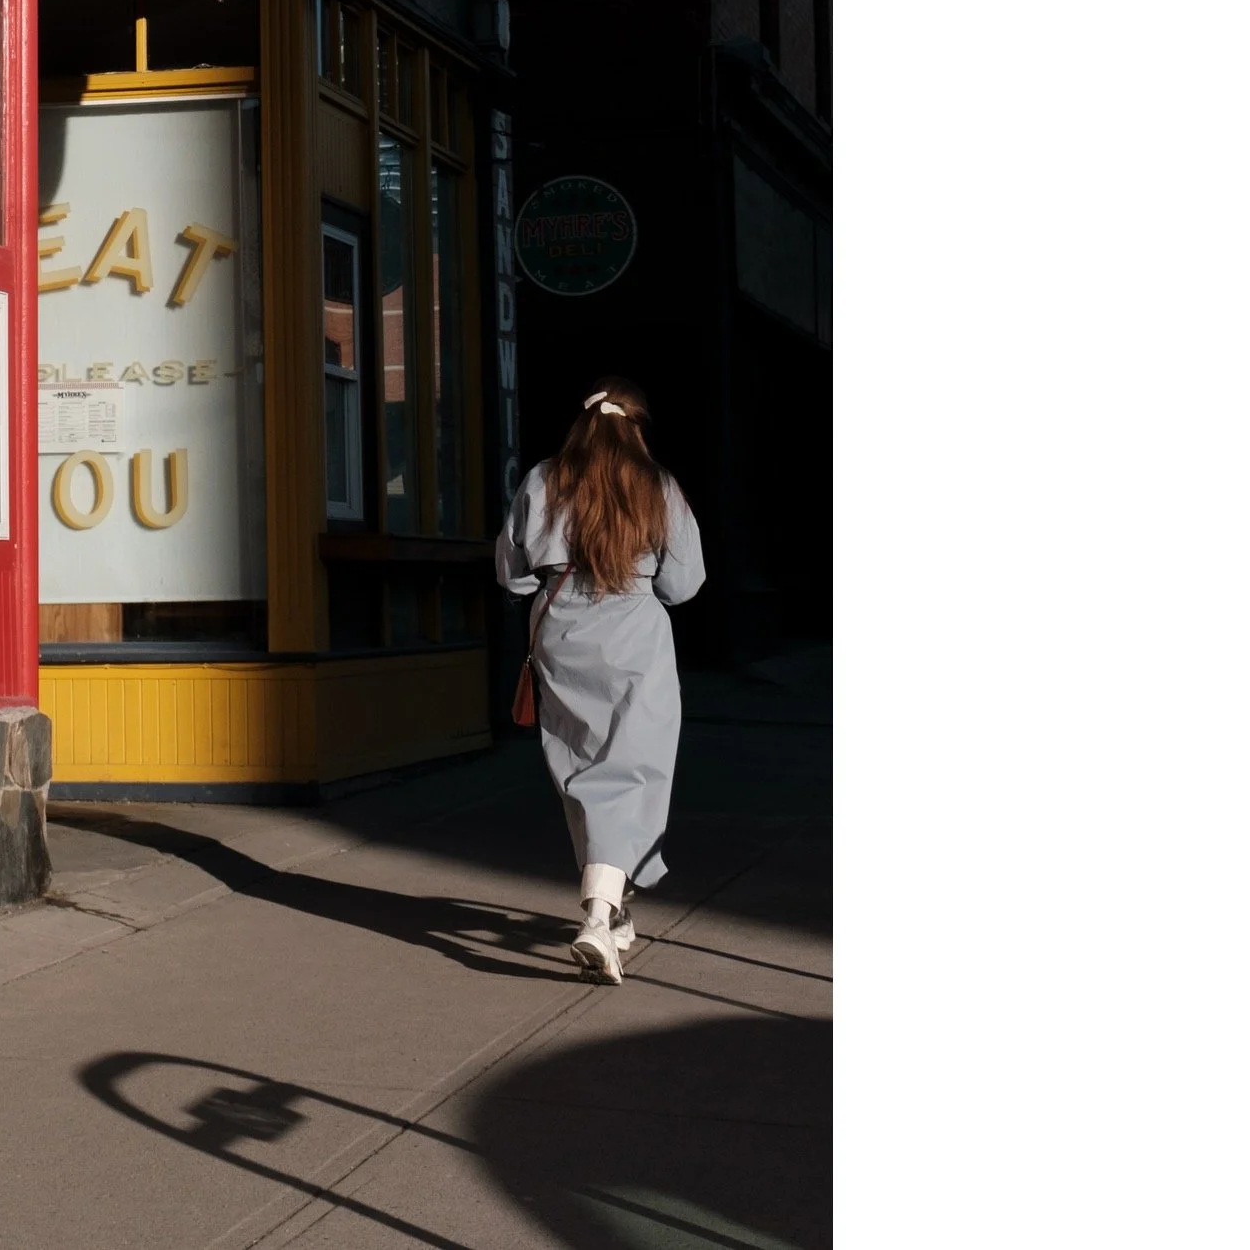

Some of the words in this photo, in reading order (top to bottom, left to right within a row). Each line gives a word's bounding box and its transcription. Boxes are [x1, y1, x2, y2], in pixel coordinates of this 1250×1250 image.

[531, 181, 618, 210] SMOKED
[522, 211, 629, 248] MYHRE'S
[38, 202, 237, 306] EAT
[550, 242, 602, 258] DELI
[535, 263, 619, 291] MEAT
[493, 112, 519, 503] SANDWIC
